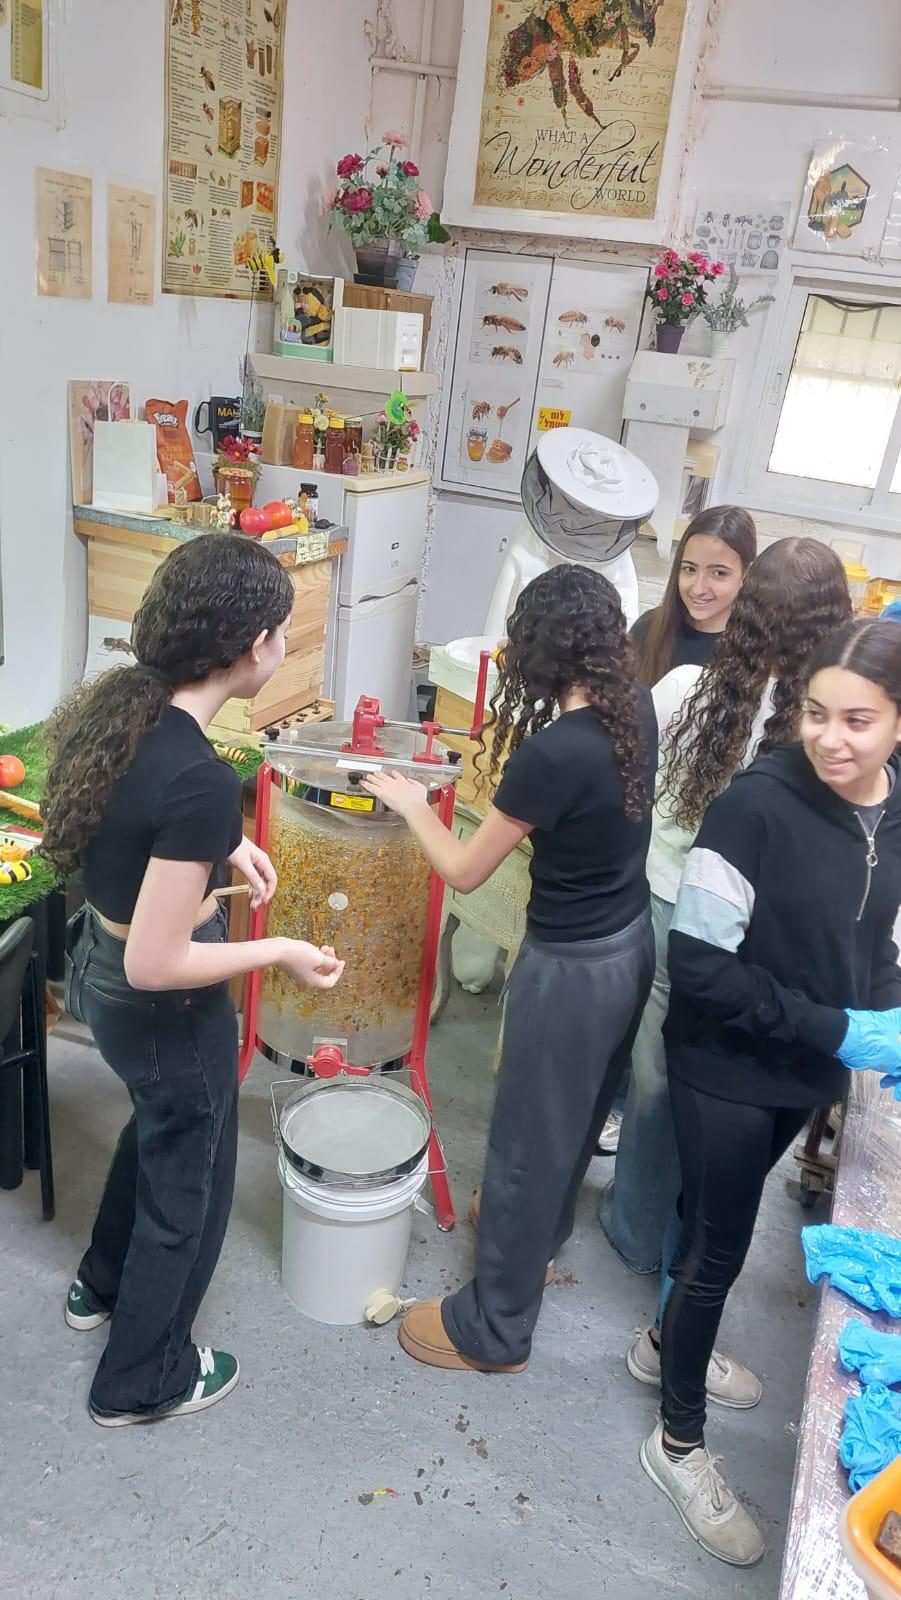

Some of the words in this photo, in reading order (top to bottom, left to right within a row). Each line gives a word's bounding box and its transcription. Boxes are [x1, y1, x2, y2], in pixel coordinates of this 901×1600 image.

[536, 128, 577, 144] WHAT
[579, 132, 589, 144] A
[484, 119, 660, 210] Wonderful
